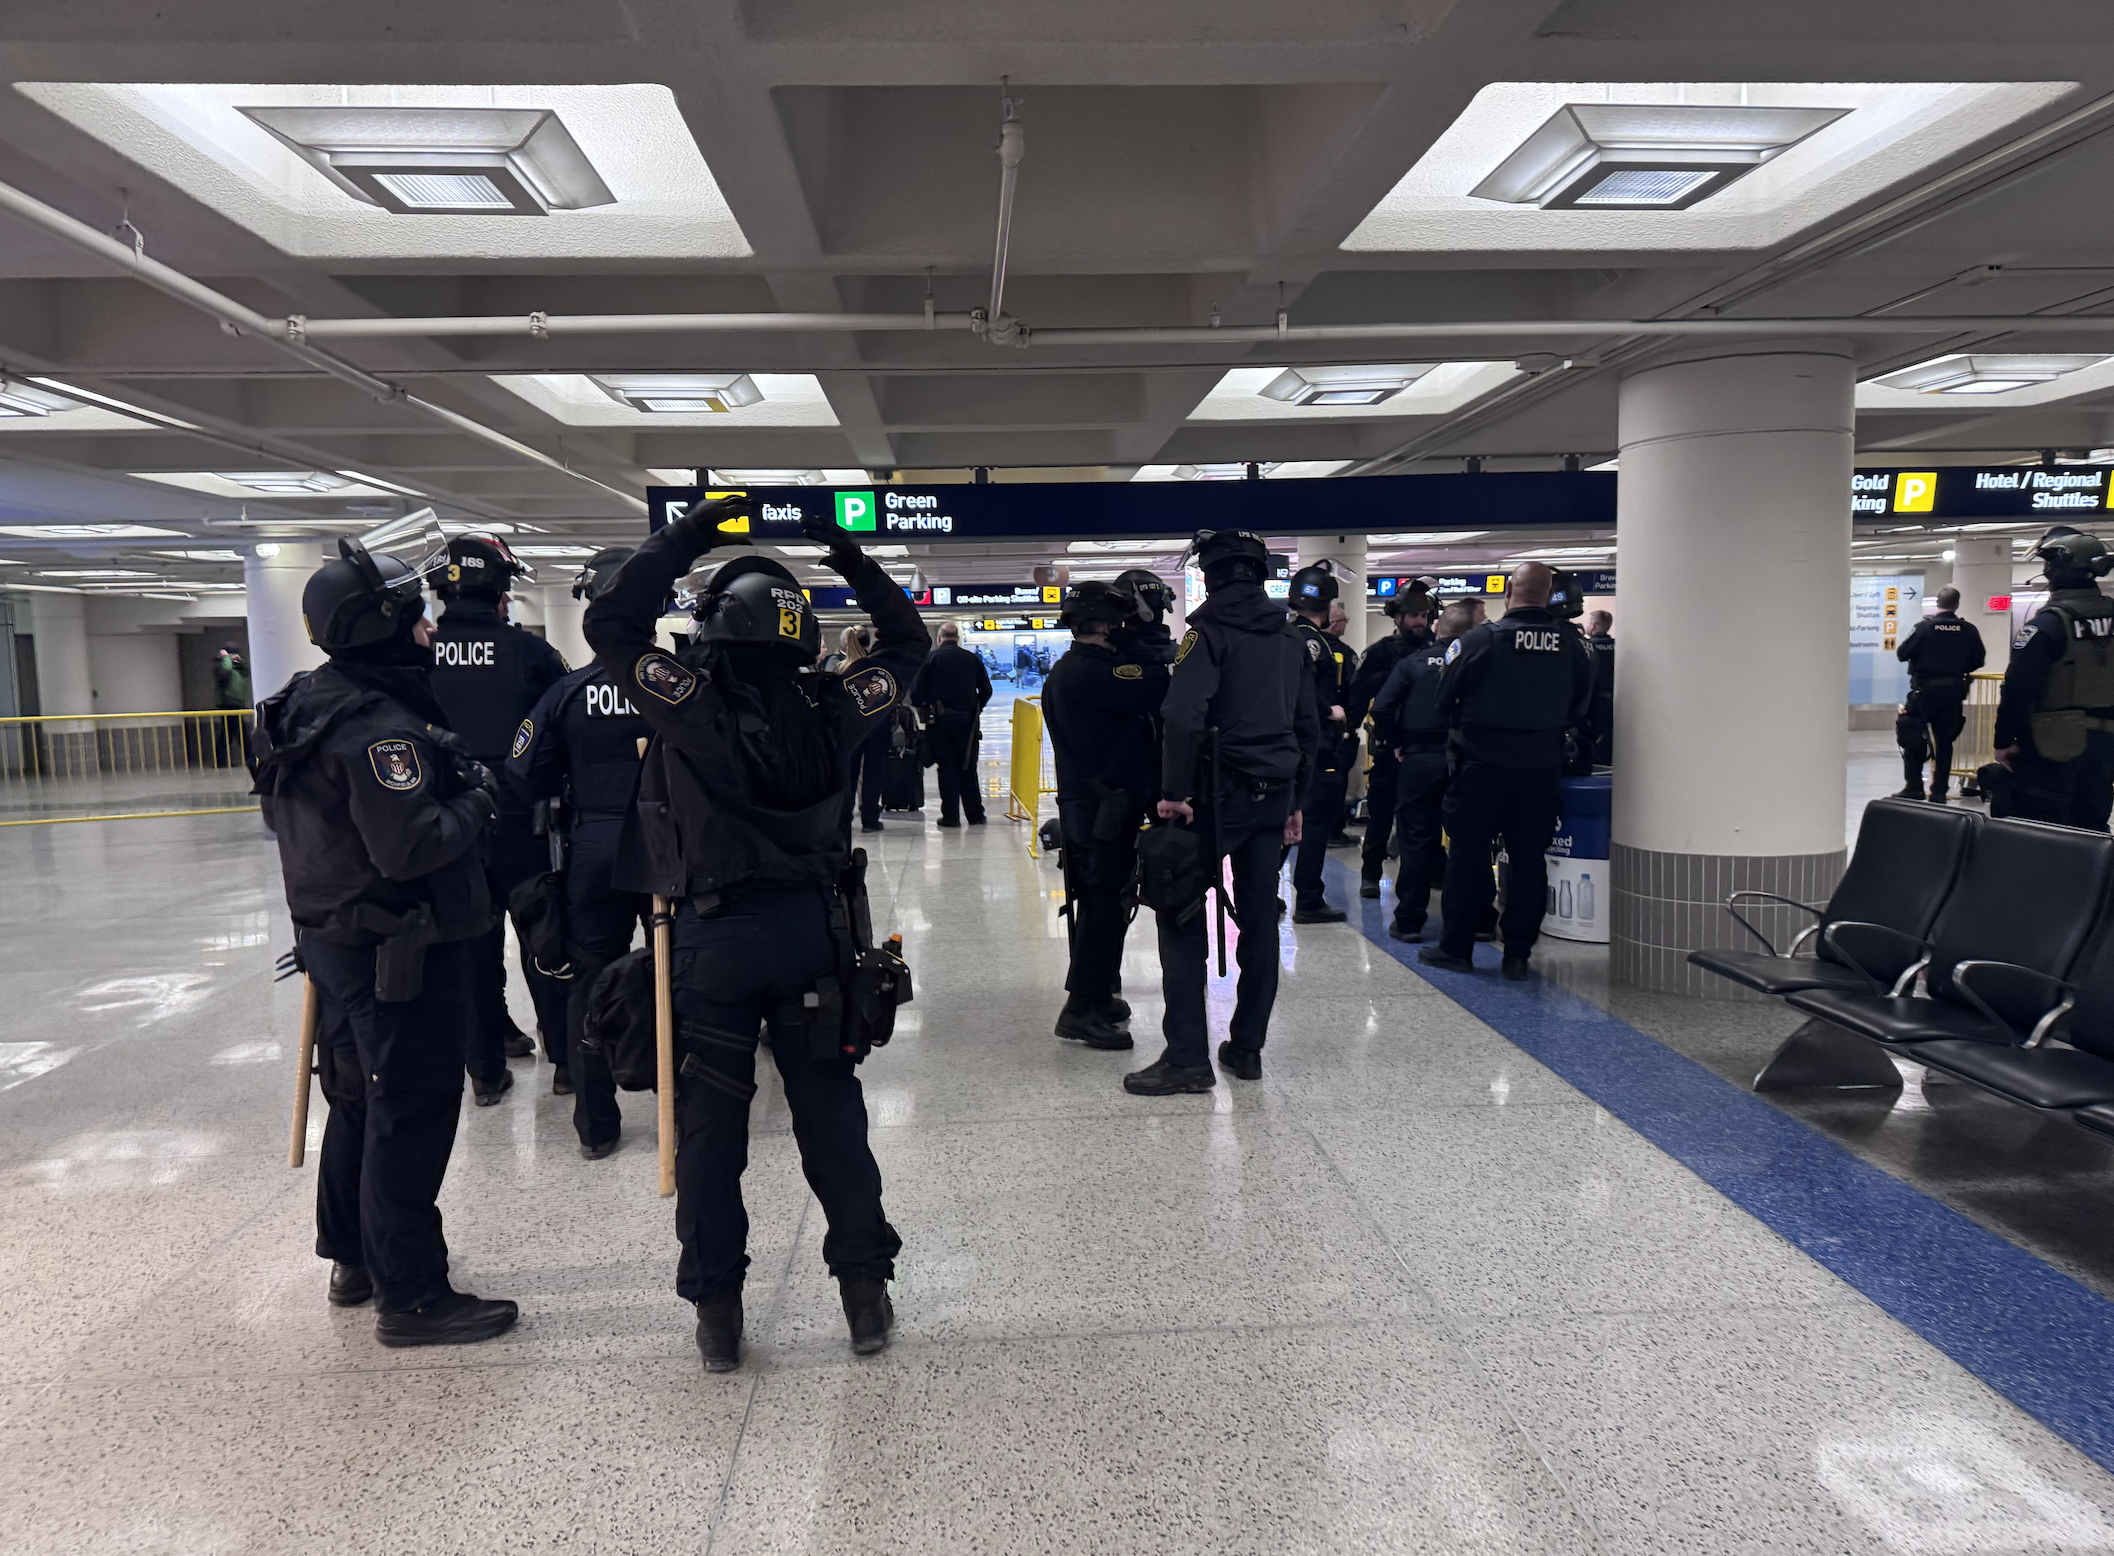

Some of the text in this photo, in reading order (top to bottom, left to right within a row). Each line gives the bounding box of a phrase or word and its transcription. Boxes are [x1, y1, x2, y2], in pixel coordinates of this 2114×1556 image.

[1851, 474, 1889, 491] Gold
[1975, 472, 2019, 489] Hotel
[2032, 471, 2102, 491] Regional
[885, 491, 938, 509] Green
[1903, 479, 1927, 506] P
[2031, 492, 2099, 508] Shuttles
[843, 497, 866, 526] P
[1851, 495, 1887, 514] king
[886, 512, 953, 533] Parking
[461, 556, 485, 569] 169
[447, 564, 461, 582] 3
[1380, 580, 1392, 594] P
[1594, 582, 1616, 590] Parkin
[770, 587, 806, 605] RPD
[776, 598, 804, 613] 202
[782, 611, 798, 636] 3
[1934, 624, 1962, 632] POLICE
[1514, 630, 1560, 652] POLICE
[435, 641, 495, 667] POLICE
[586, 684, 640, 716] POLI
[376, 743, 408, 753] POLICE
[1551, 835, 1573, 848] xed
